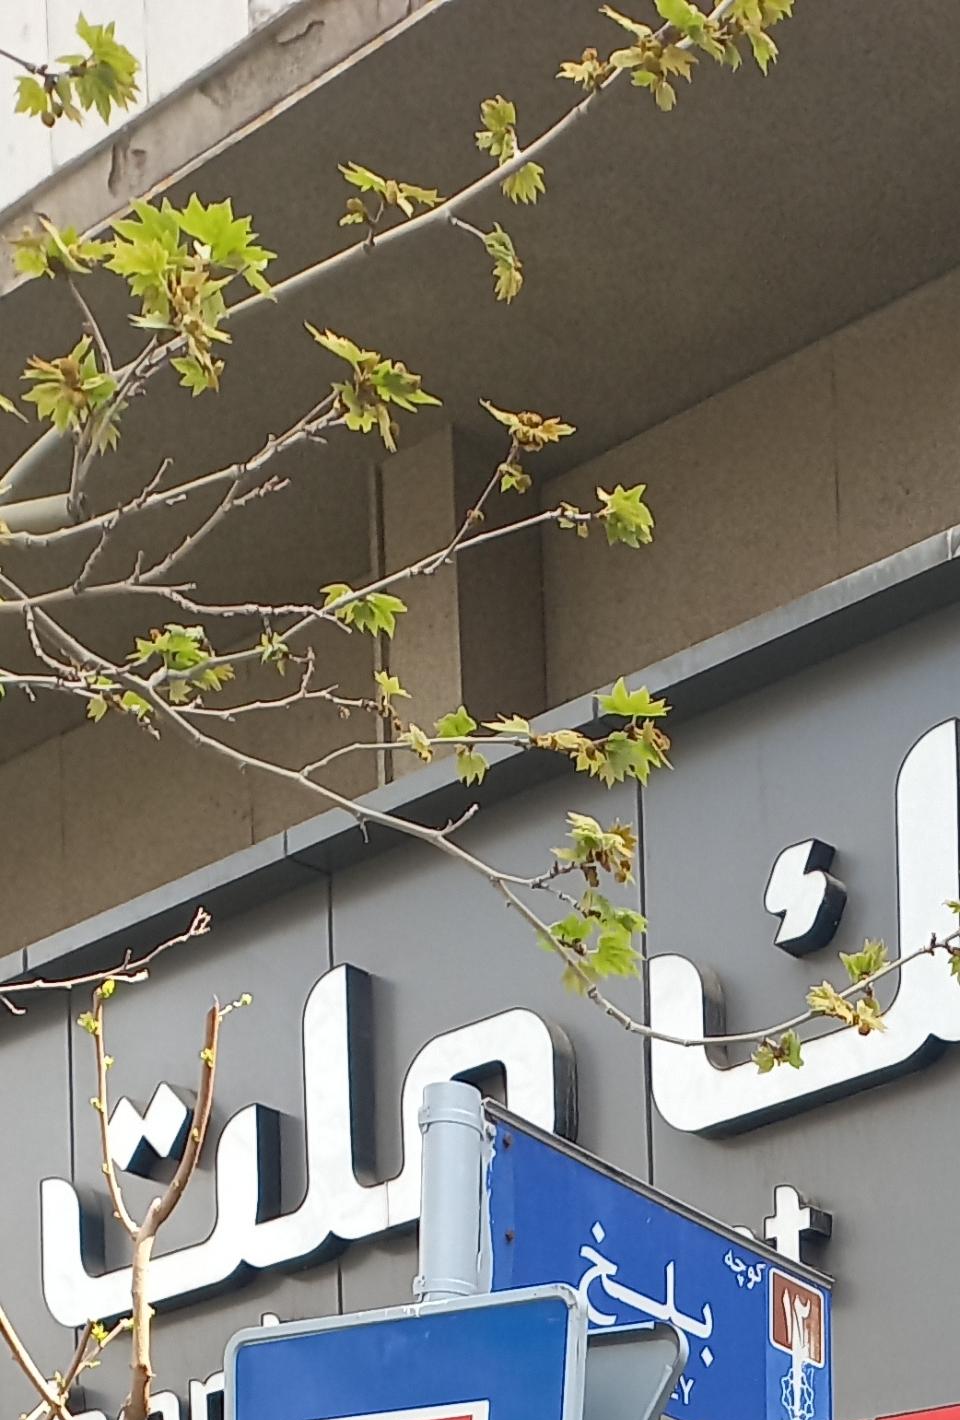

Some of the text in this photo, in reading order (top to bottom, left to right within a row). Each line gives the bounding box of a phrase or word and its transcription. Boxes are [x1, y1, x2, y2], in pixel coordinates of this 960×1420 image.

[40, 963, 577, 1328] ملت
[579, 1221, 713, 1368] بلخ
[724, 1250, 766, 1289] کوچه
